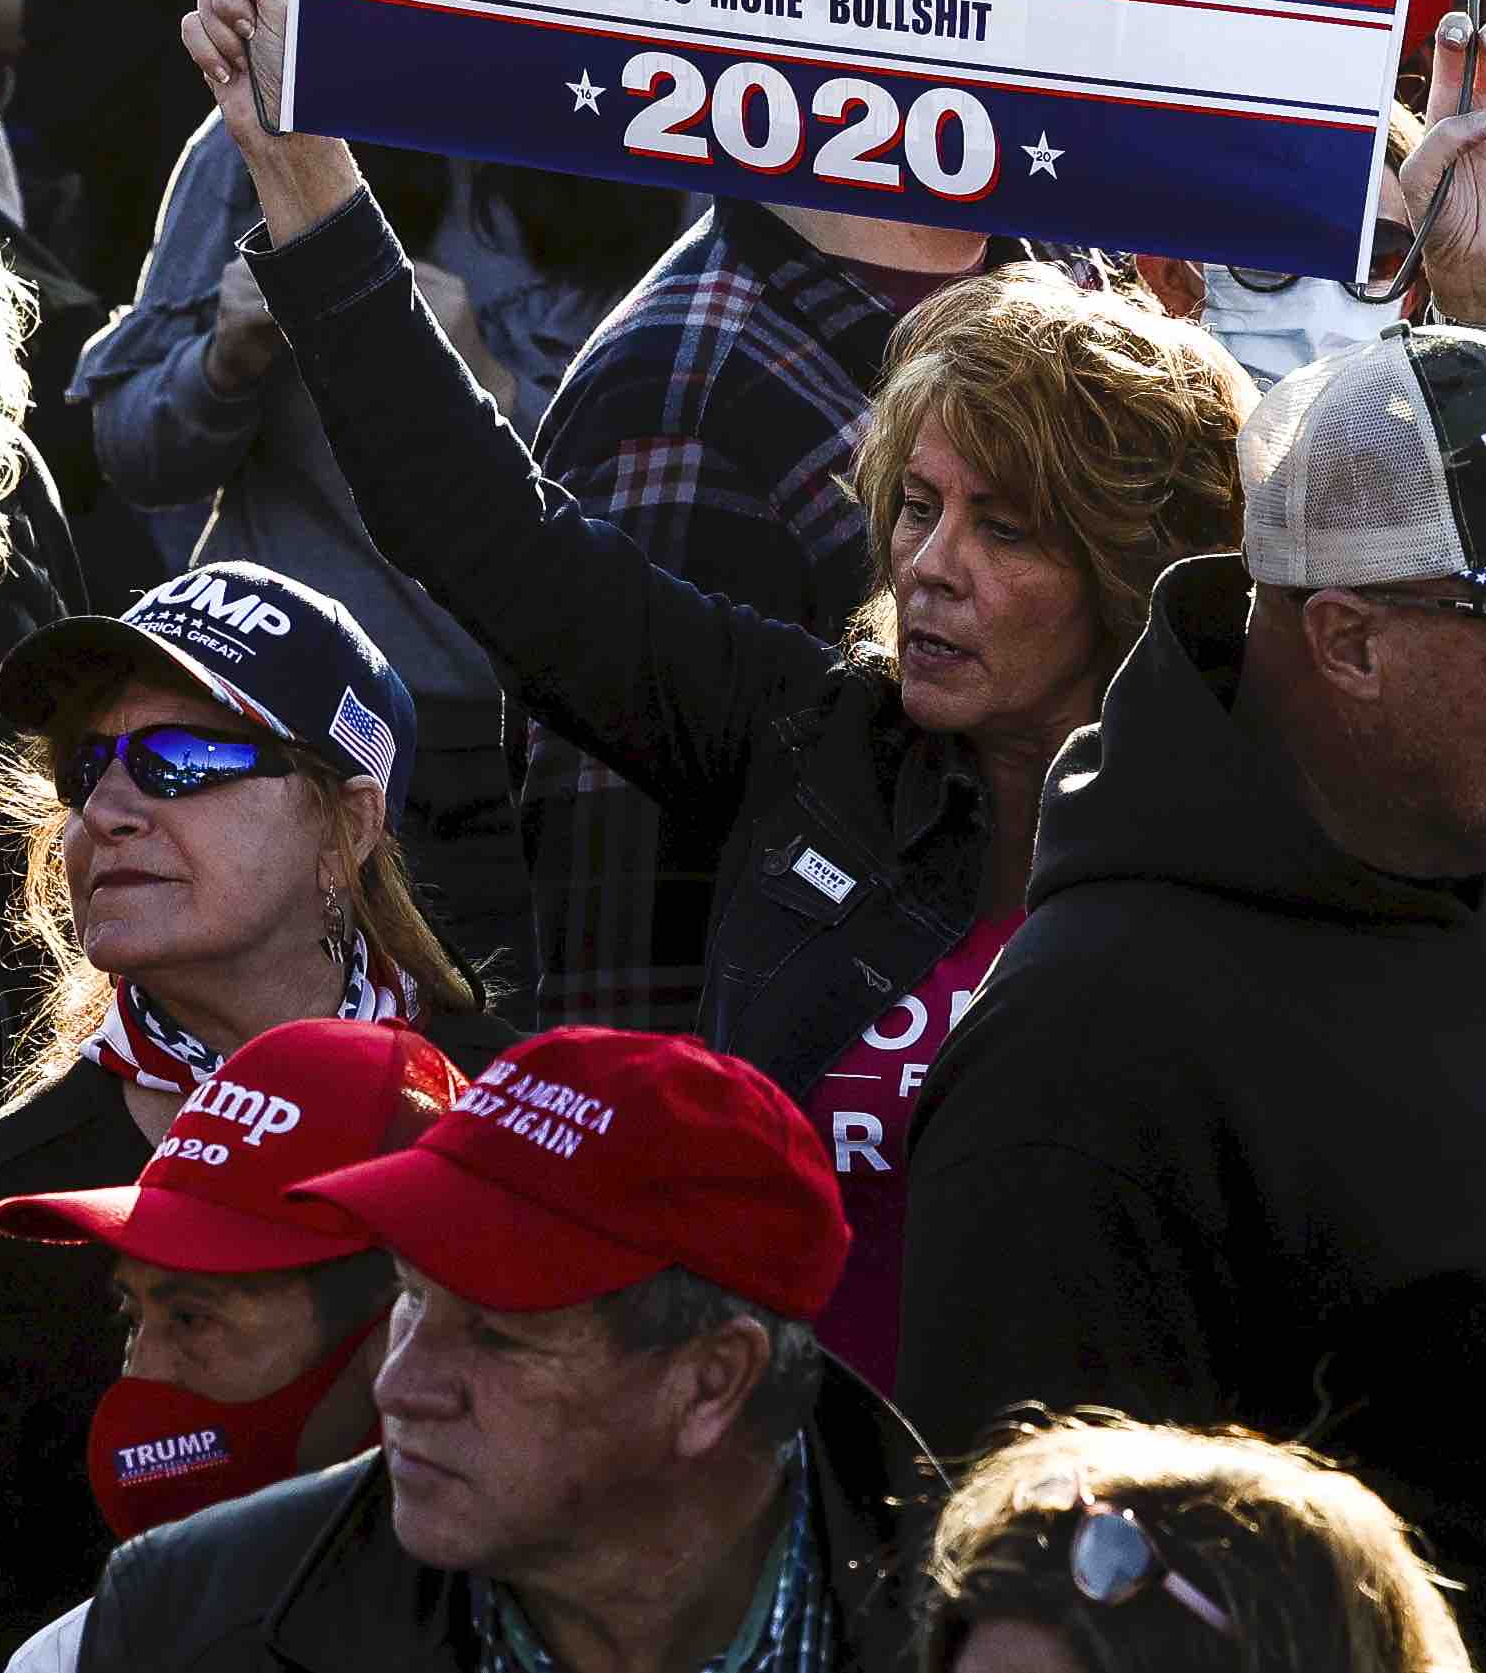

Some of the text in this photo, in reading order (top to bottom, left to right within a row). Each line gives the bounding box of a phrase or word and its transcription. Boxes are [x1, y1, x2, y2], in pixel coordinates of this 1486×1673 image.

[621, 50, 1002, 204] 2020
[808, 855, 847, 887] TRUMP
[496, 1104, 584, 1160] AGAIN
[506, 1074, 614, 1136] AMERICA
[118, 1430, 217, 1469] TRUMP
